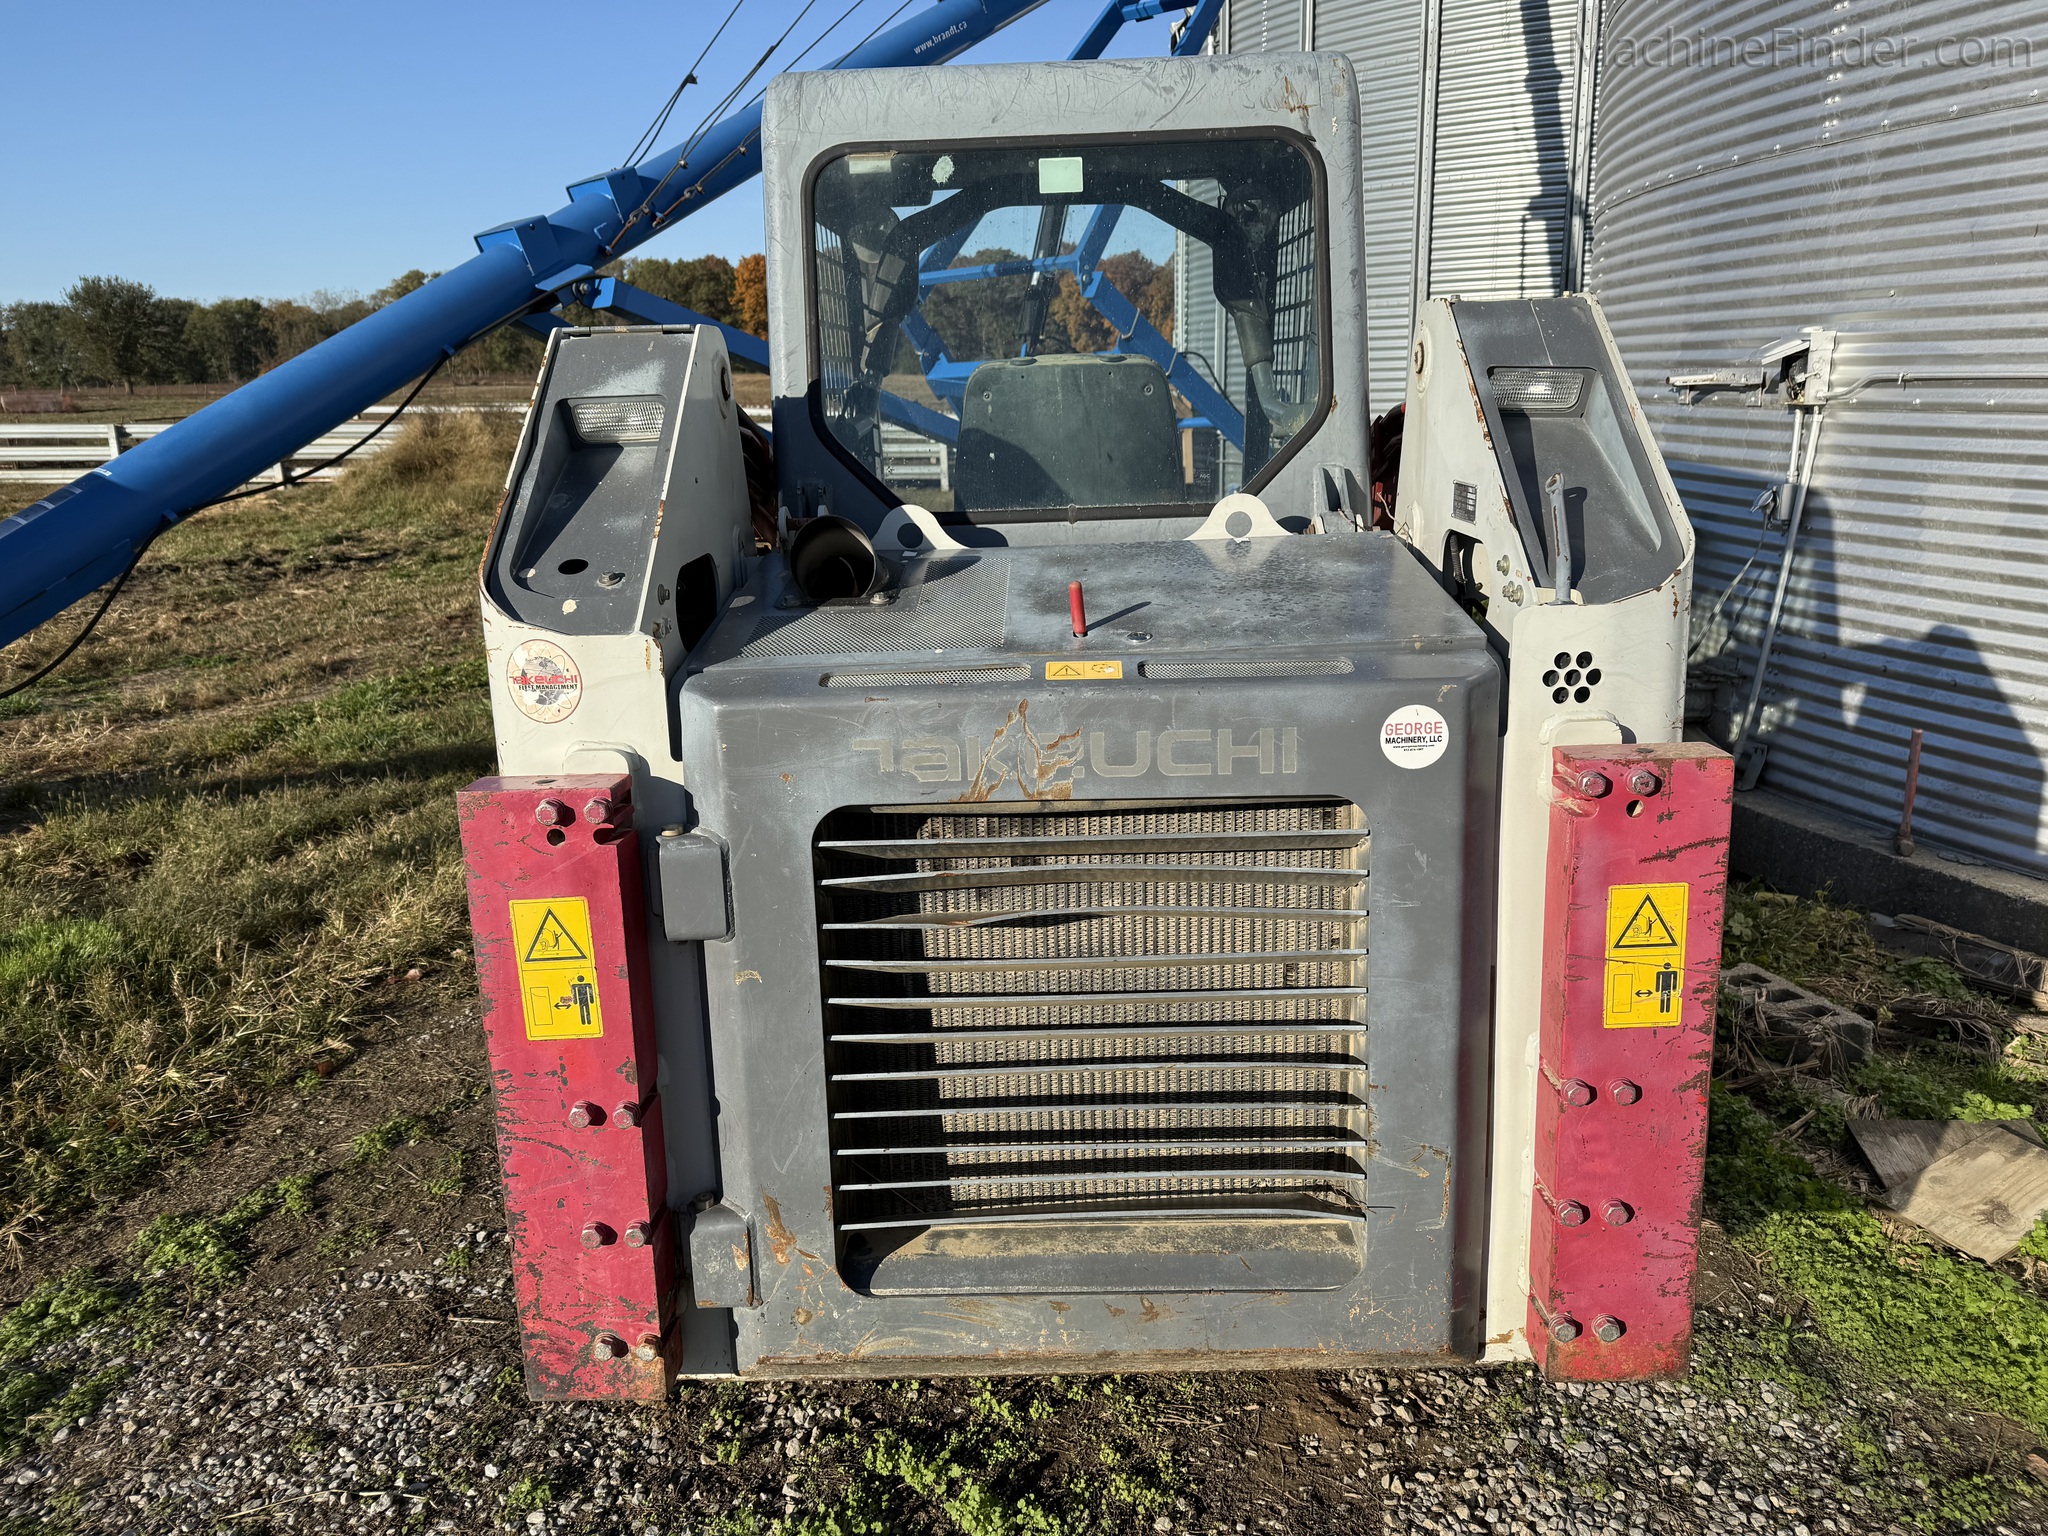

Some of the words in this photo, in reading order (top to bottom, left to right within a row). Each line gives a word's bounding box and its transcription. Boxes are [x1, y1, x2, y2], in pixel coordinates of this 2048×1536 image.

[1385, 722, 1443, 736] GEORGE
[1385, 736, 1428, 745] MACHINERY,
[1429, 735, 1442, 743] LLC
